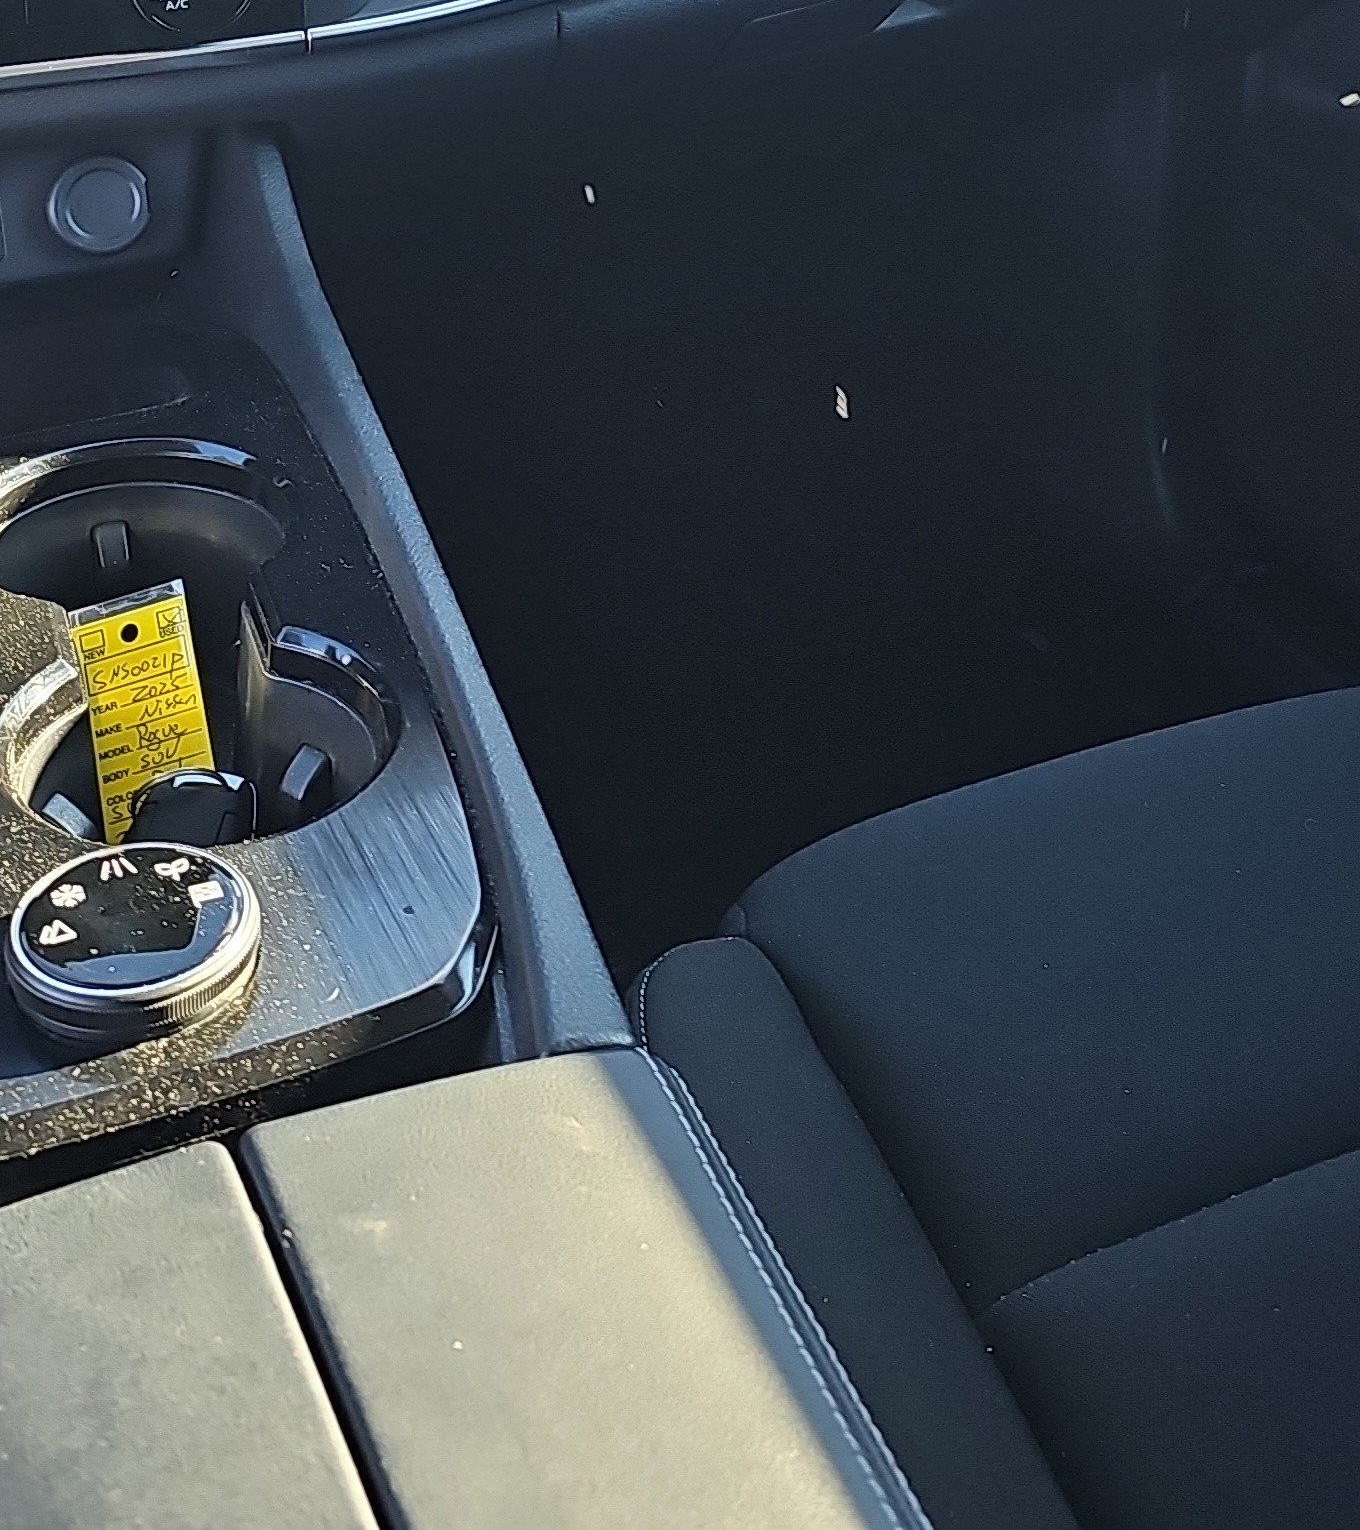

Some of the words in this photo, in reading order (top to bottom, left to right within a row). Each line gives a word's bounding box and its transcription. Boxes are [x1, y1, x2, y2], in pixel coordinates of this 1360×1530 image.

[159, 624, 184, 639] USED
[83, 647, 106, 661] NEW
[91, 700, 119, 717] YEAR
[95, 722, 124, 739] MAKE
[98, 744, 135, 762] MODEL
[102, 767, 131, 785] BODY
